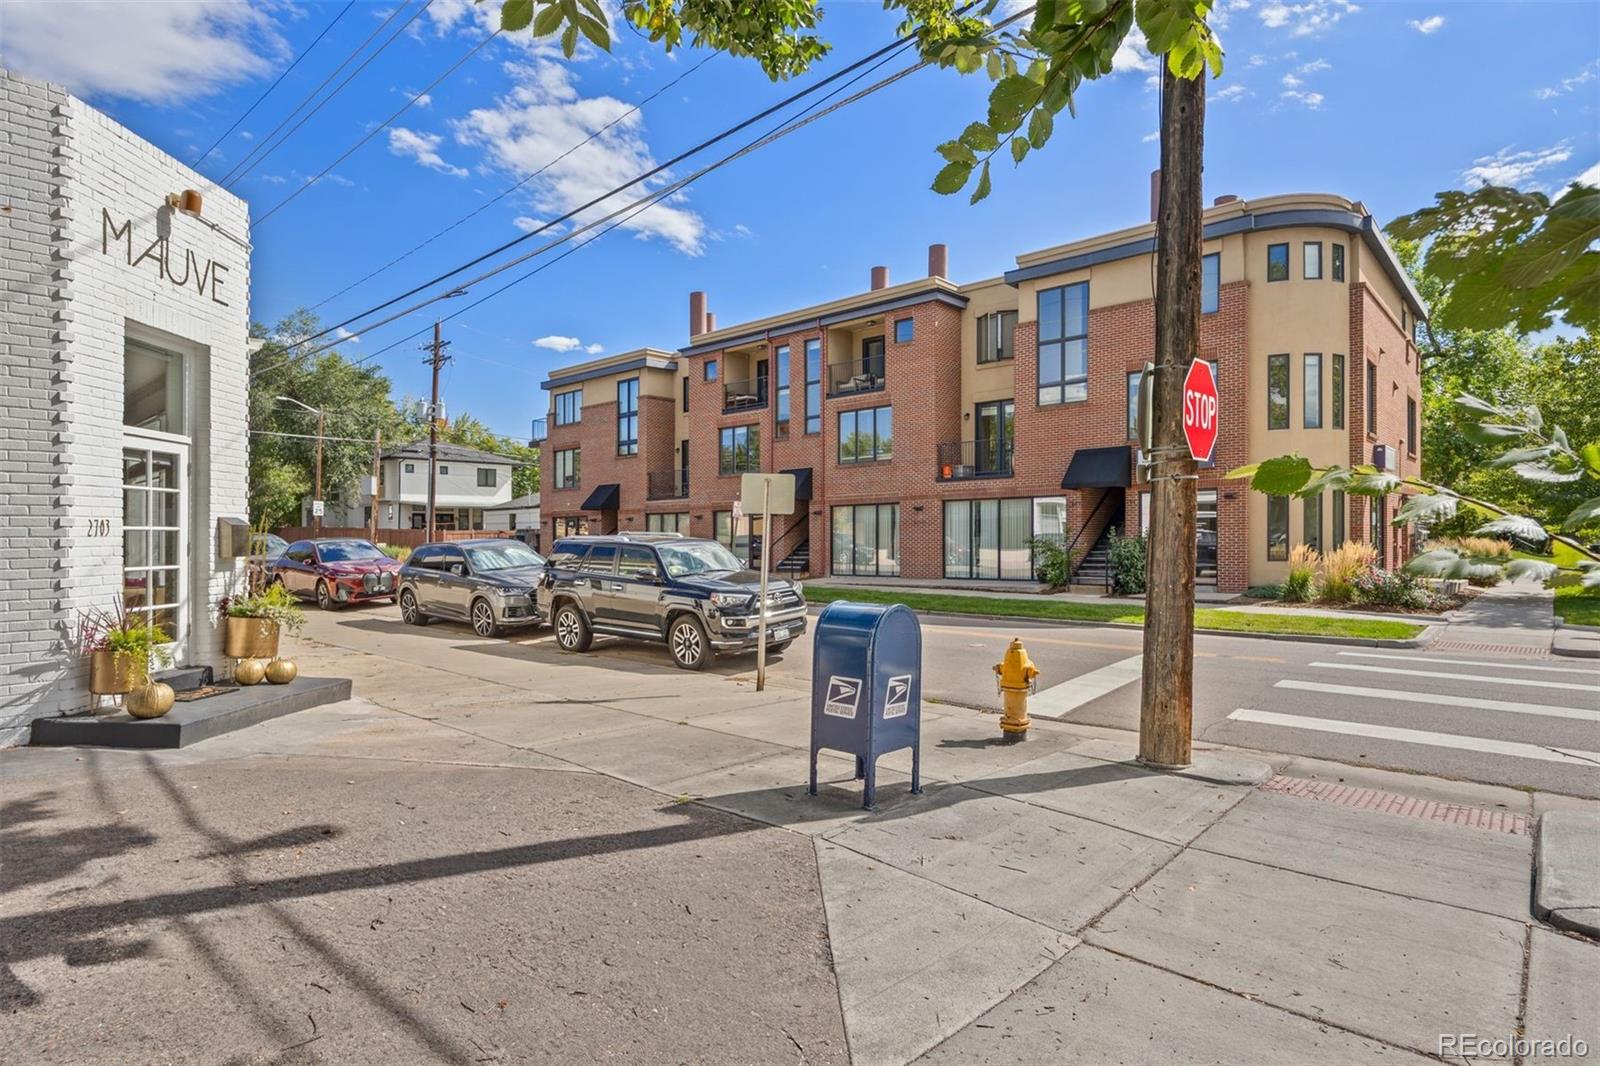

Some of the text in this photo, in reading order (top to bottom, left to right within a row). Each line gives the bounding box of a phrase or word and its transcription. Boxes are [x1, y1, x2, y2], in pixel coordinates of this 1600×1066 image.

[102, 207, 229, 307] MAUVE
[1186, 389, 1216, 430] STOP
[87, 519, 110, 537] 2703
